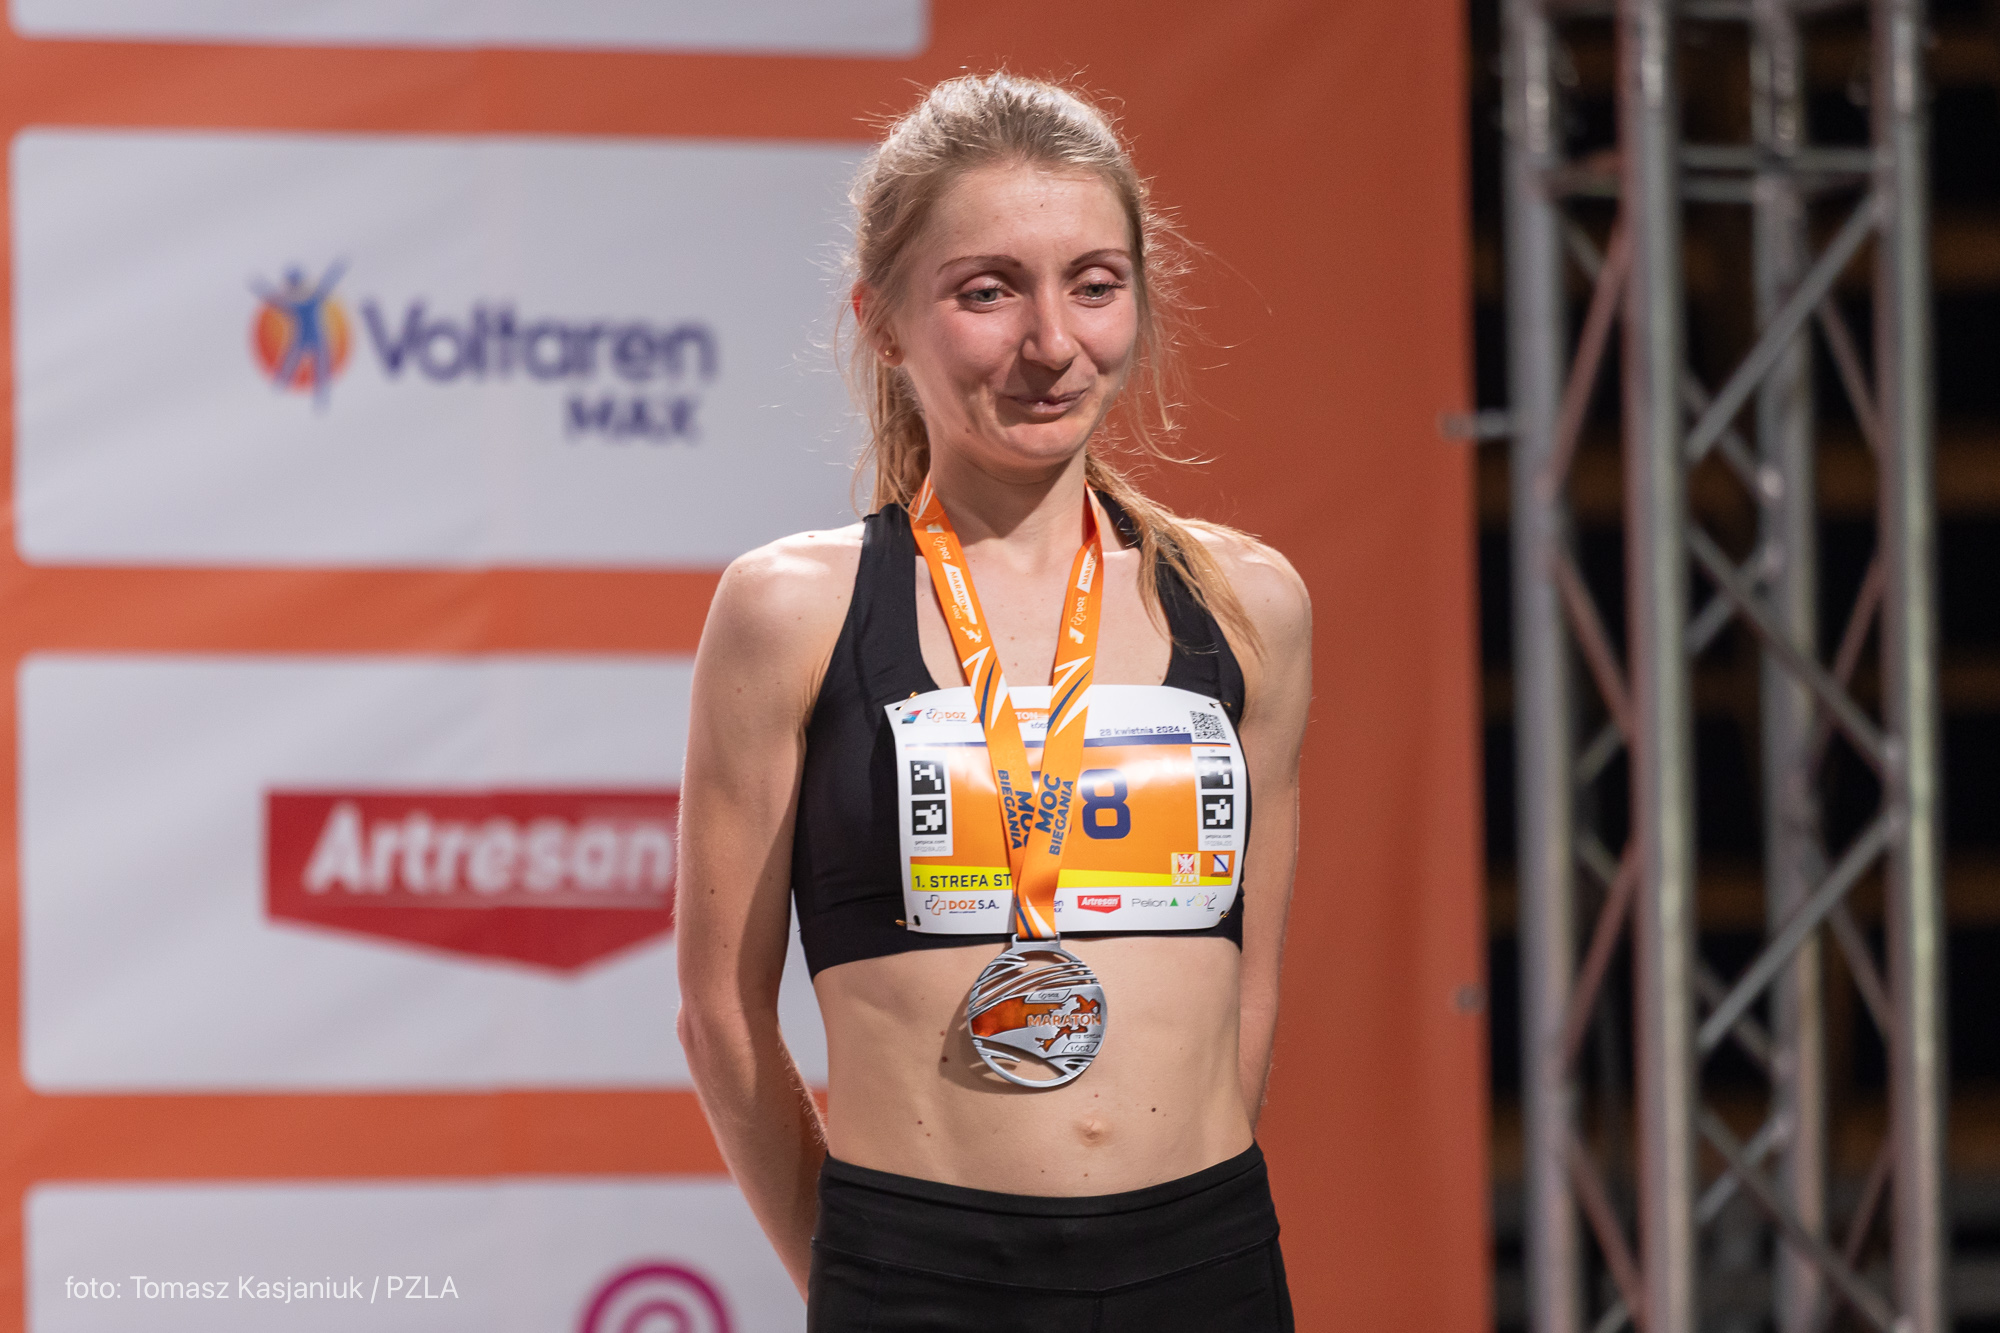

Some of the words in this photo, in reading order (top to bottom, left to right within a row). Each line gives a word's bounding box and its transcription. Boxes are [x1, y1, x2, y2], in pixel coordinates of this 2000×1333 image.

[362, 299, 718, 381] Voltaren
[566, 395, 702, 443] MAX
[950, 571, 969, 610] MARATON
[945, 711, 966, 719] DOZ
[1115, 726, 1154, 735] kwietnia
[1156, 725, 1180, 733] 2024
[997, 770, 1023, 850] BIEGANIA
[1015, 790, 1035, 848] MO
[1035, 773, 1061, 833] MOC
[1048, 781, 1074, 856] BIEGANIA
[1071, 768, 1131, 840] 8
[304, 804, 674, 893] Artresan
[914, 875, 925, 888] 1.
[930, 875, 988, 888] STREFA
[1081, 897, 1119, 907] Artresan
[1132, 898, 1168, 907] Pelion
[949, 900, 976, 910] DOZ
[1027, 1014, 1101, 1027] MARATON
